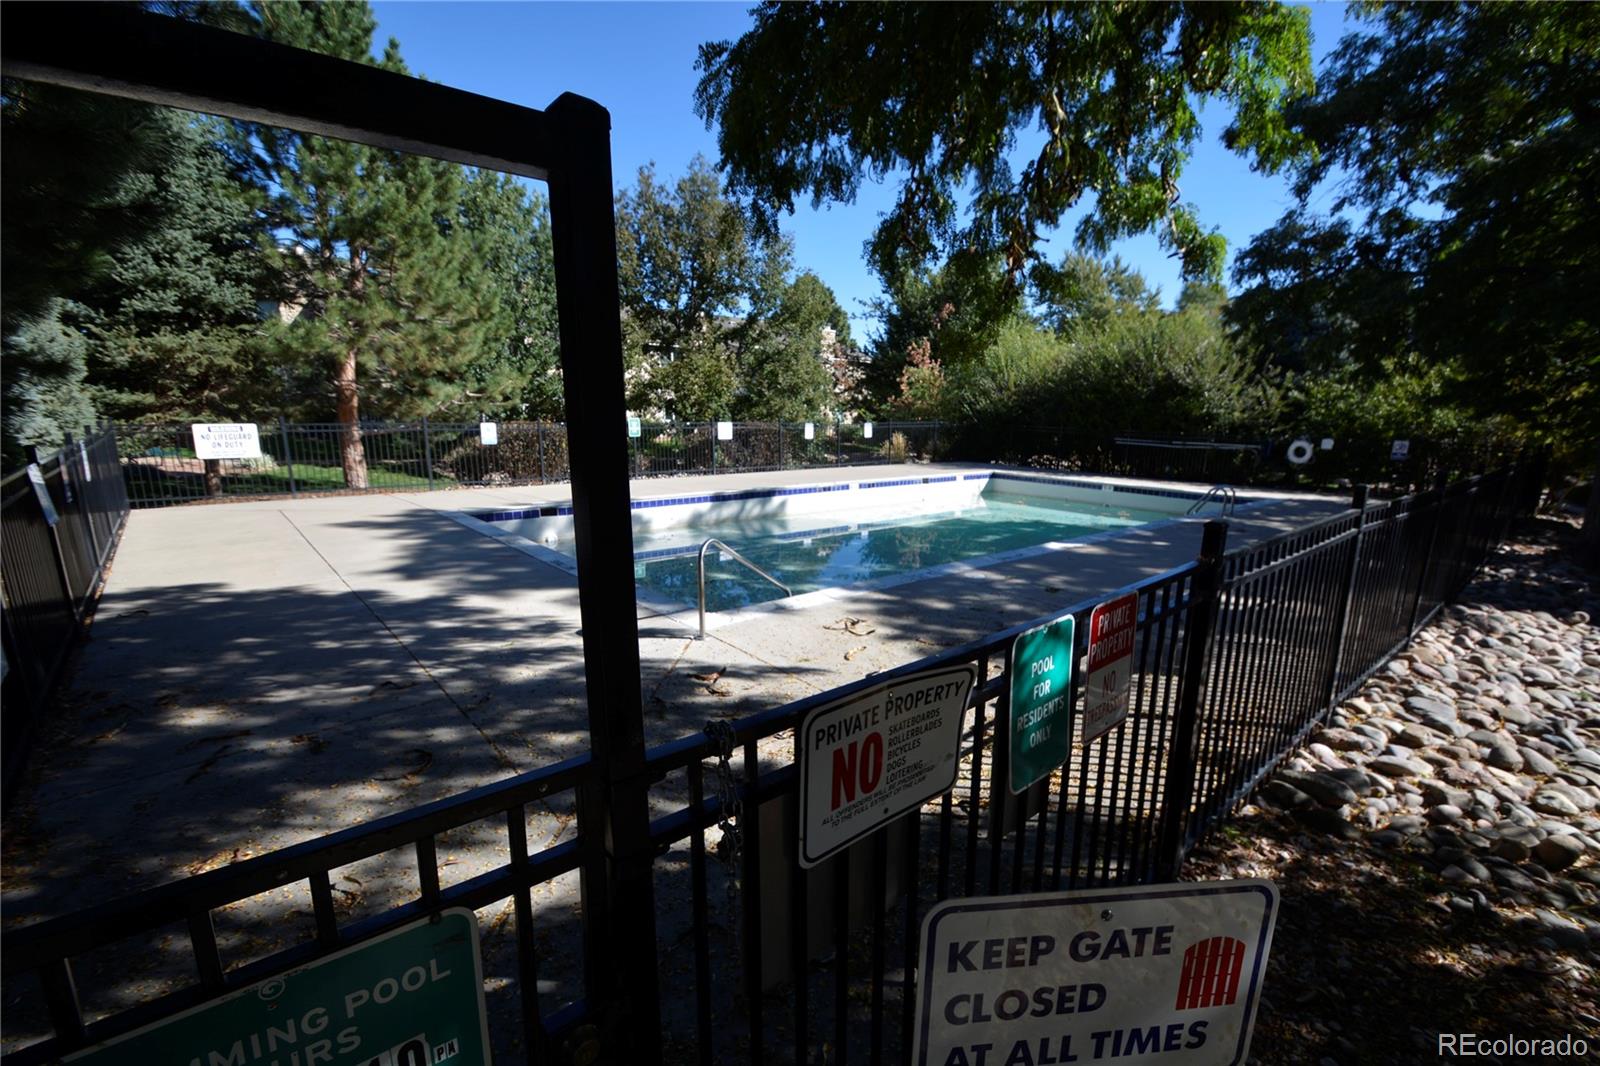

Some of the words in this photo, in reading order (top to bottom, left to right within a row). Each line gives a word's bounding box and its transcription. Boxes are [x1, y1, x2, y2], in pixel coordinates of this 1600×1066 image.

[1097, 603, 1132, 636] PRIVATE
[1090, 626, 1134, 664] PROPERTY
[1031, 655, 1055, 678] POOL
[1033, 679, 1051, 700] FOR
[1103, 670, 1116, 697] NO
[815, 705, 880, 750] PRIVATE
[884, 680, 966, 720] PROPERTY
[888, 707, 941, 736] SKATEBOARDS
[1016, 695, 1065, 733] RESIDENTS
[887, 718, 943, 748] ROLLERBLADES
[1029, 723, 1053, 749] ONLY
[886, 756, 907, 773] DOGS
[887, 738, 921, 761] BICYCLES
[831, 731, 884, 812] NO
[886, 759, 924, 785] LOITERING
[947, 935, 1056, 974] KEEP
[1068, 925, 1175, 963] GATE
[345, 959, 452, 1019] POOL
[944, 982, 1107, 1026] CLOSED
[944, 1042, 994, 1066] AT
[1004, 1034, 1078, 1066] ALL
[1090, 1020, 1209, 1060] TIMES
